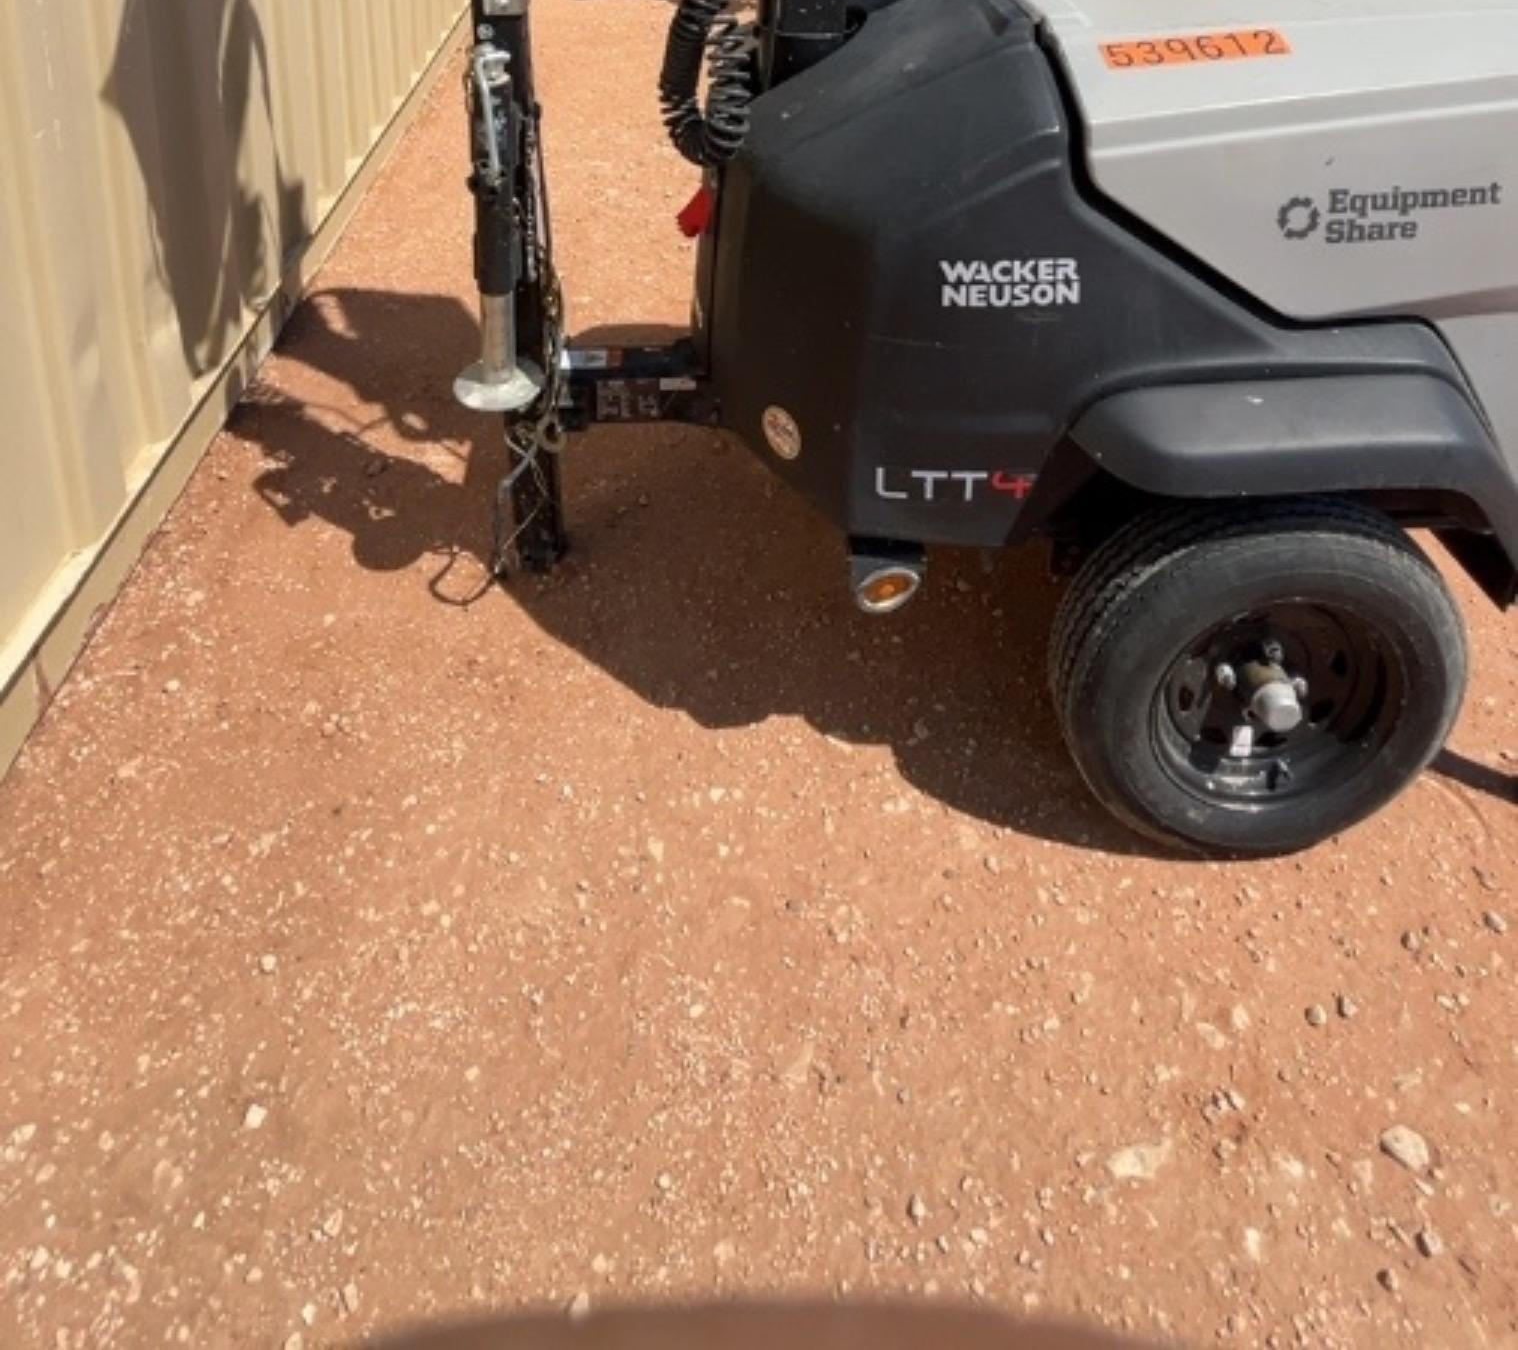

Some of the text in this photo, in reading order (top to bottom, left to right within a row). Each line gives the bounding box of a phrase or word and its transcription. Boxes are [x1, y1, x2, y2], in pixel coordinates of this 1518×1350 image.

[1105, 29, 1286, 67] 539612
[1327, 182, 1502, 218] Equipment
[1325, 219, 1418, 244] Share
[939, 258, 1080, 283] WACKER
[941, 281, 1081, 308] NEUSON
[875, 467, 1035, 501] LTT4
